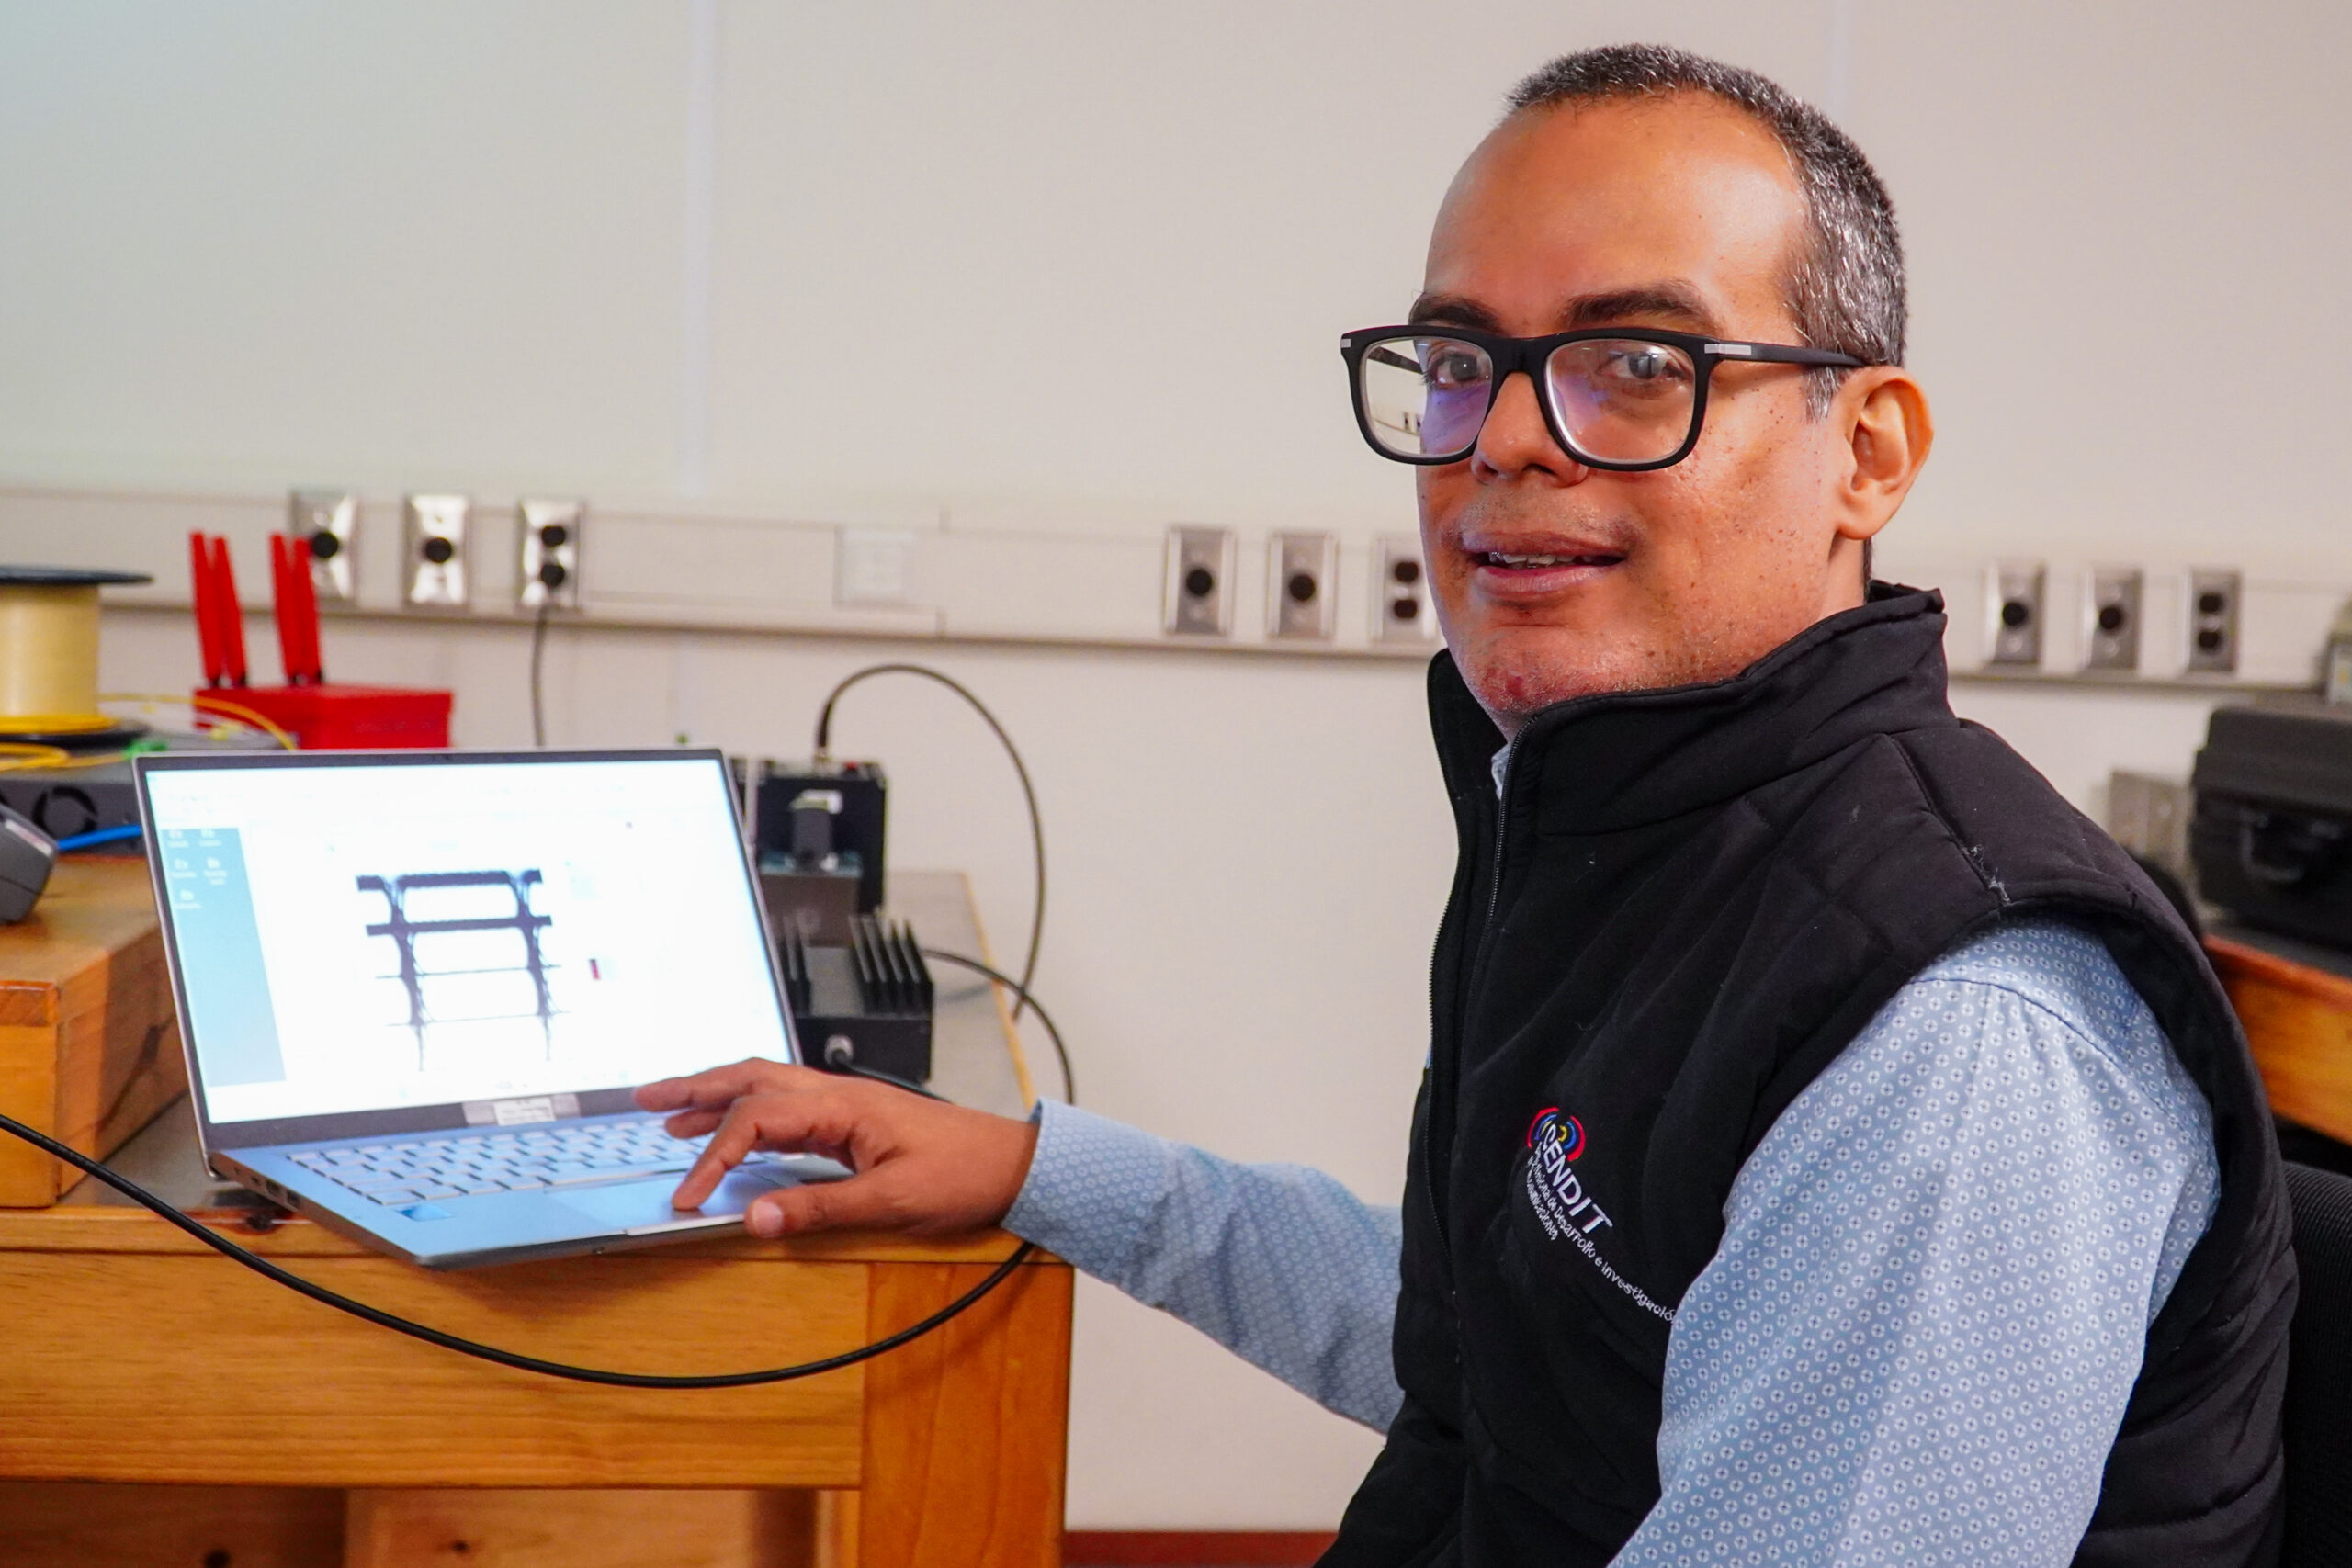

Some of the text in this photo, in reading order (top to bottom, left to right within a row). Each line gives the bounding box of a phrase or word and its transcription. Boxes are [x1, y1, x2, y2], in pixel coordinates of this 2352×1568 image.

[1542, 1123, 1613, 1234] CENDIT
[1555, 1205, 1597, 1258] Desarrollo
[1594, 1256, 1603, 1268] e
[1601, 1261, 1675, 1323] investigació
